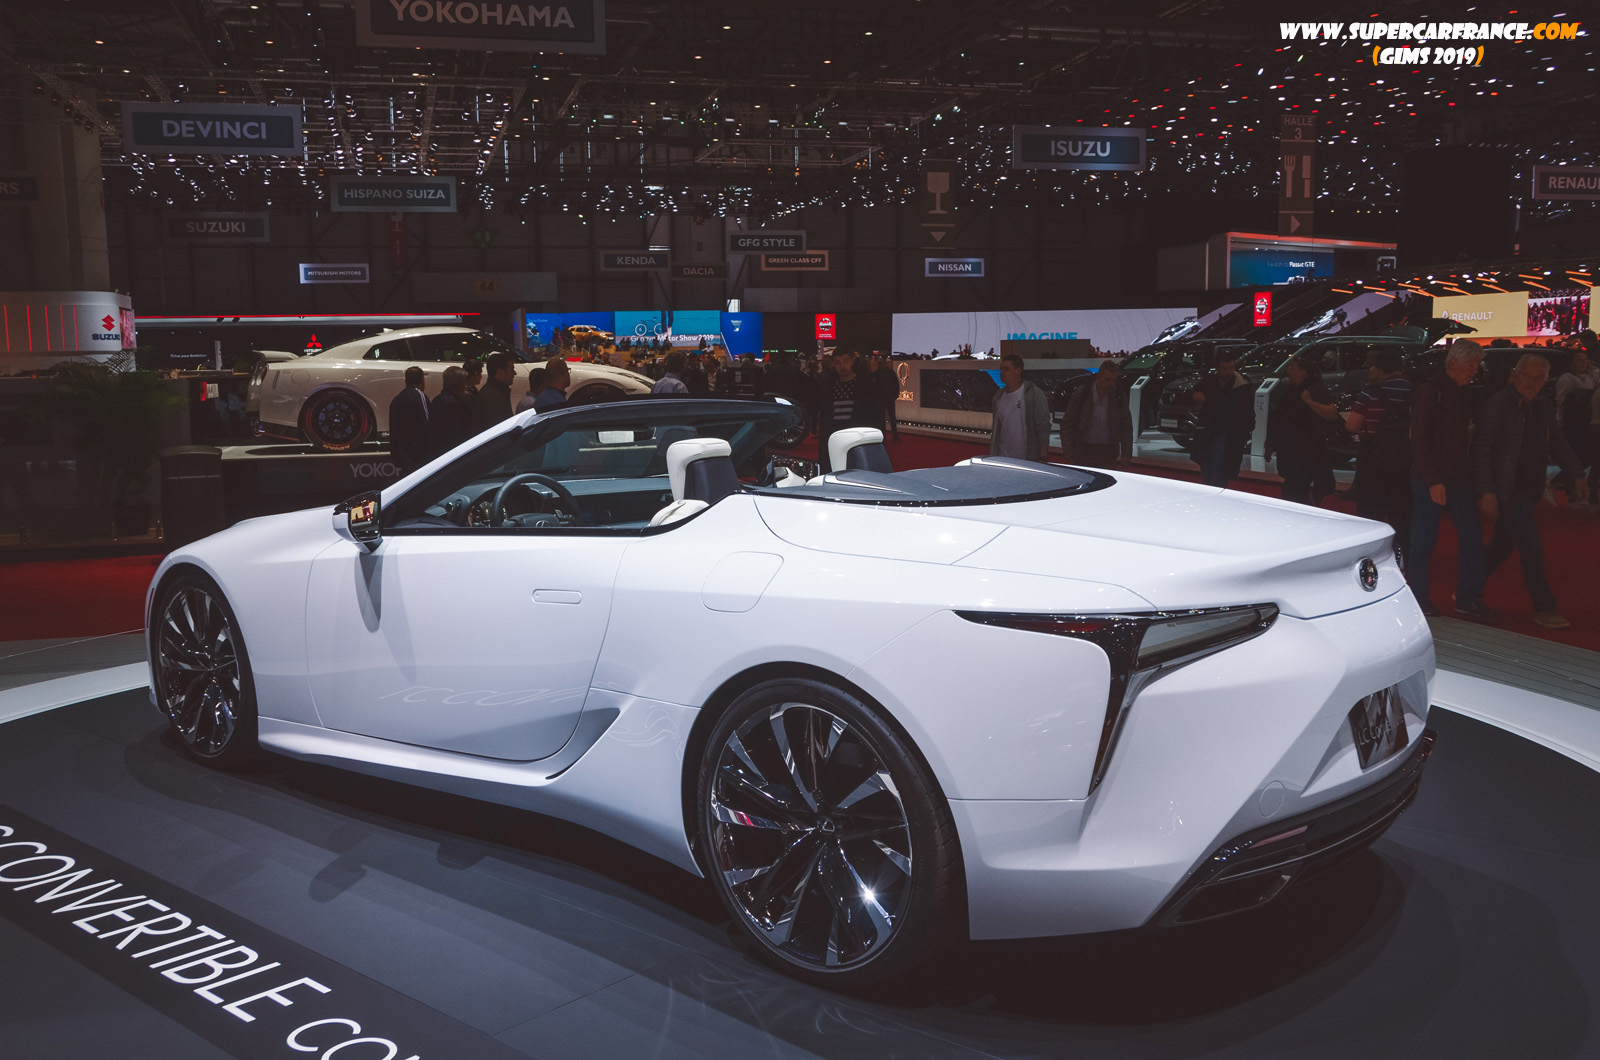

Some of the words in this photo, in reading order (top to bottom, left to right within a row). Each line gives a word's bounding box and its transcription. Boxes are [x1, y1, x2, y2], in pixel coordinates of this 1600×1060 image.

[389, 0, 575, 29] YOKOHAMA
[1283, 116, 1314, 126] HALLE
[162, 119, 268, 140] DEVINCI
[1294, 127, 1303, 140] 3
[1050, 140, 1112, 158] ISUZU
[343, 188, 403, 200] HISPANO
[406, 188, 446, 200] SUIZA
[186, 221, 246, 233] SUZUKI
[738, 238, 760, 247] GFG
[763, 238, 795, 247] STYLE
[616, 256, 656, 265] KENDA
[683, 267, 715, 276] DACIA
[938, 263, 972, 273] NISSAN
[478, 281, 495, 292] 44
[1451, 310, 1494, 322] RENAULT
